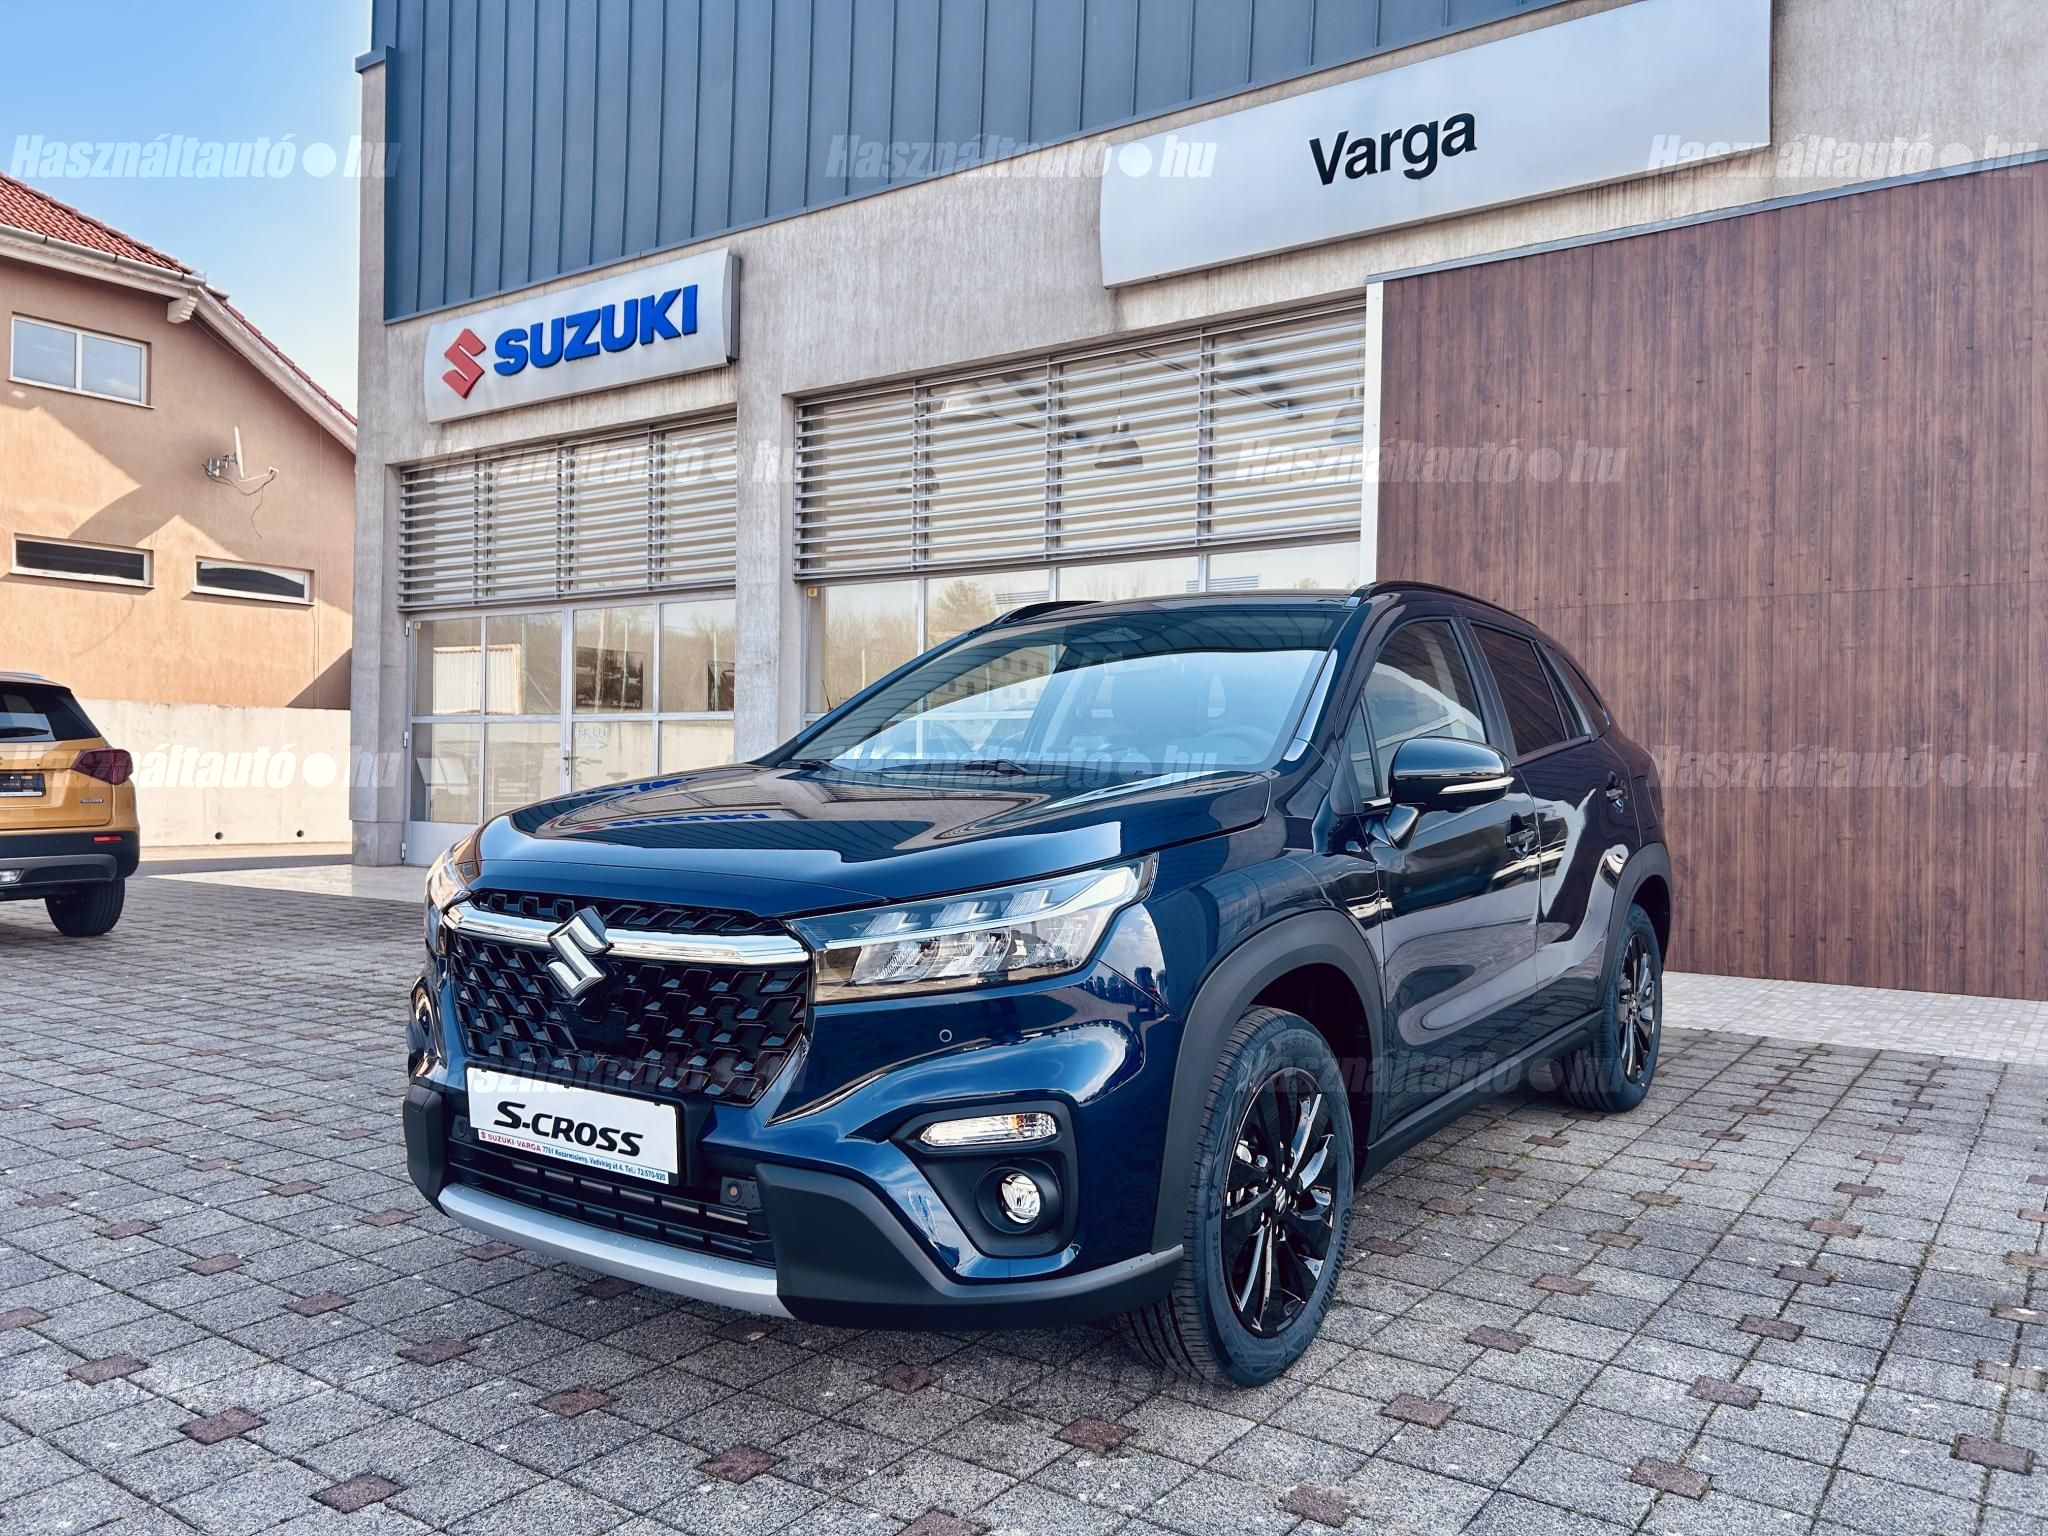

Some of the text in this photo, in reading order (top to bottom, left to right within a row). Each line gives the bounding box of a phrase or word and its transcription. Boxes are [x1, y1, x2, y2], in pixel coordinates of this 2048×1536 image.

[1308, 111, 1478, 186] Varga
[494, 284, 698, 376] SUZUKI
[494, 1101, 643, 1156] S-CROSS
